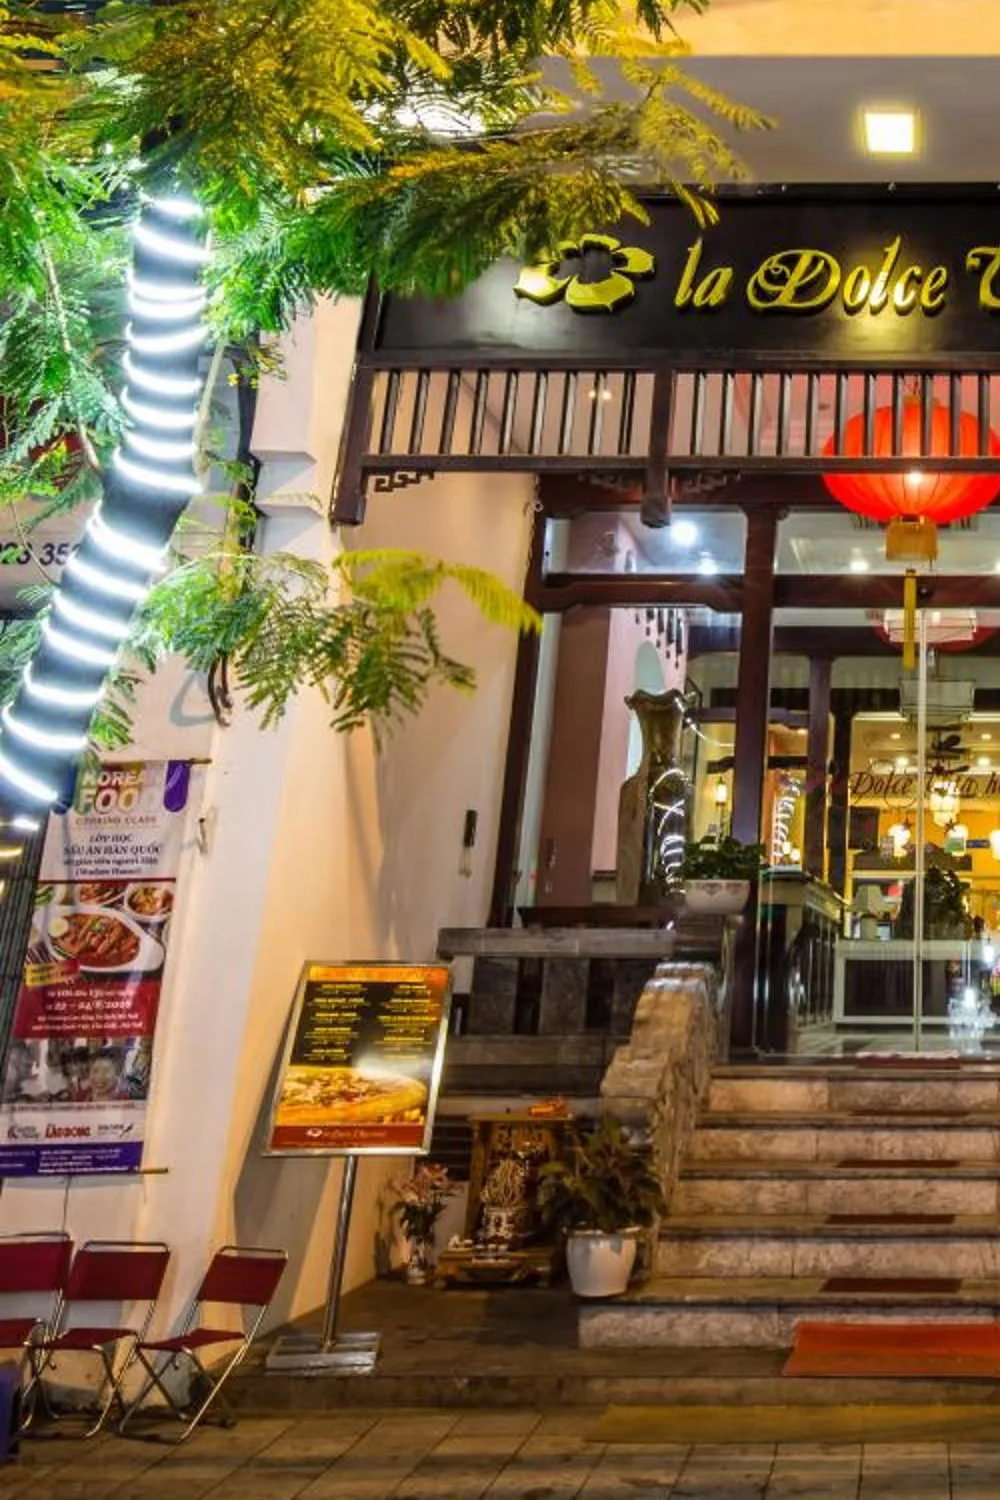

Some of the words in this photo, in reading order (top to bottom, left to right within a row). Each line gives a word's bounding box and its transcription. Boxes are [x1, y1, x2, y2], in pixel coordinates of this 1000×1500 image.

[675, 236, 734, 308] la
[747, 236, 947, 311] Dolce
[81, 771, 150, 787] KOREA
